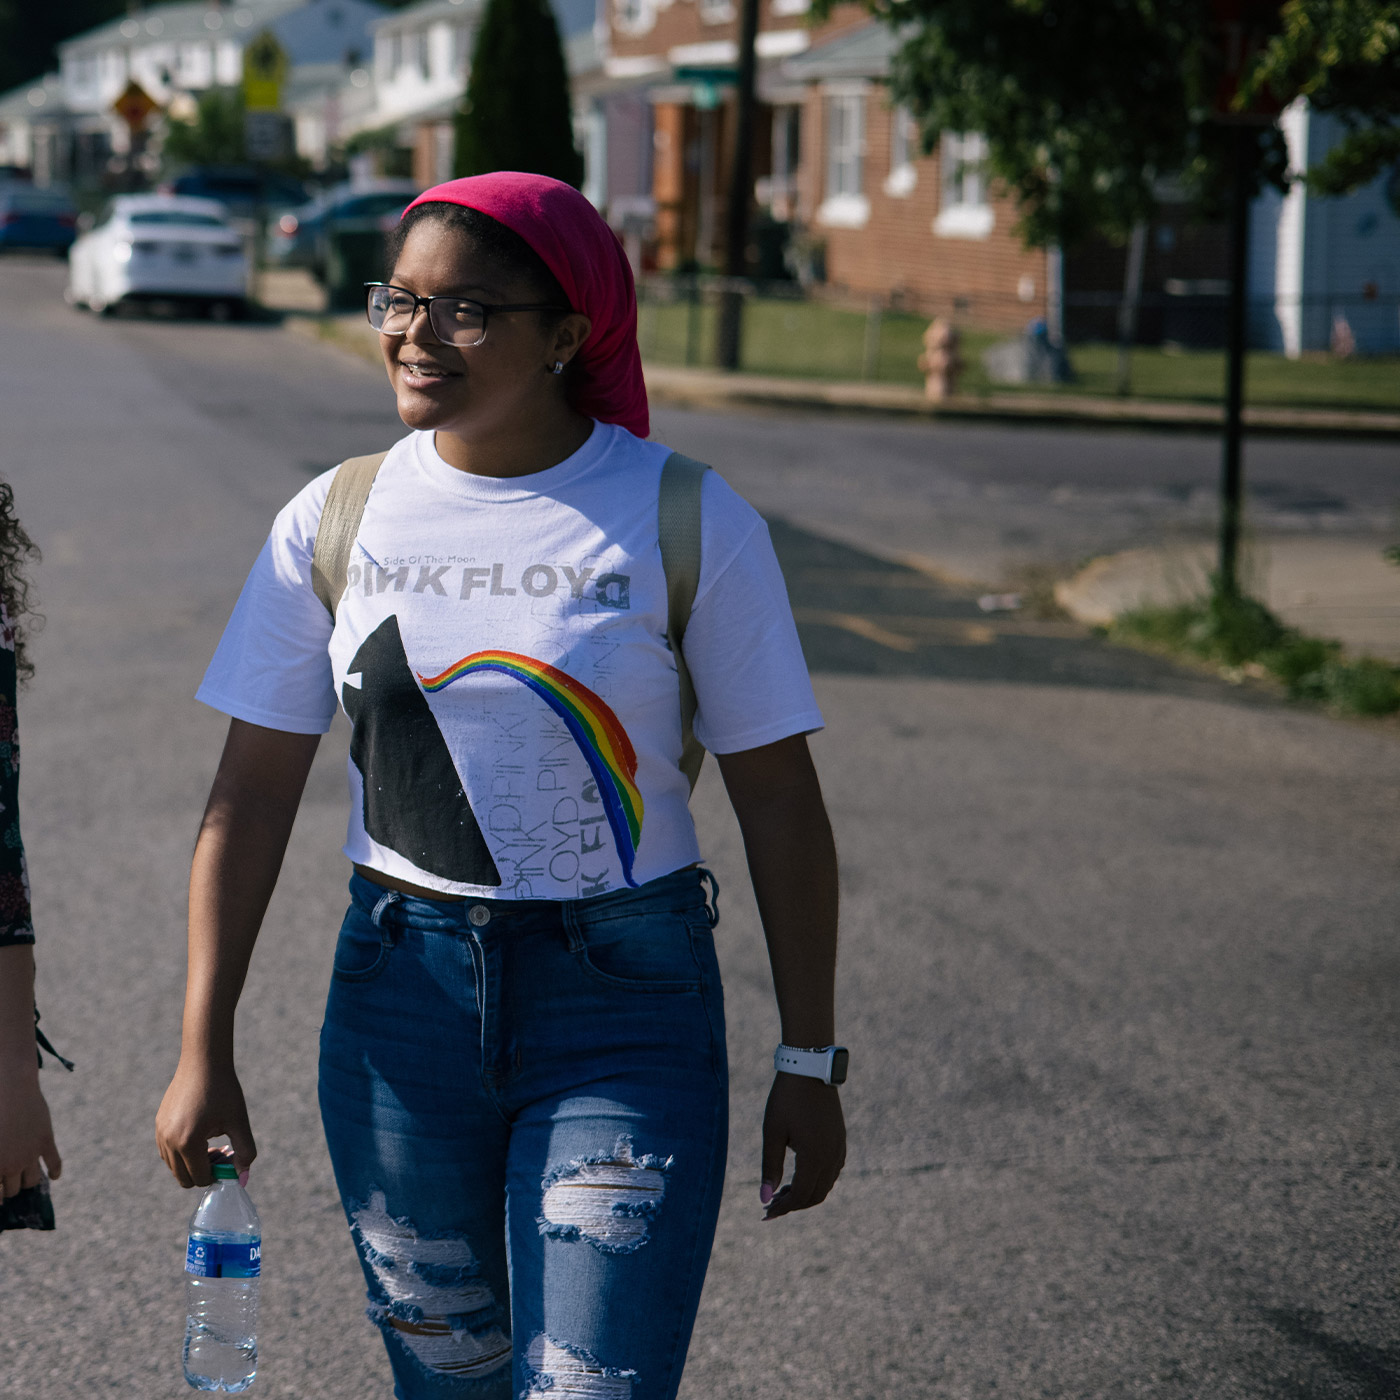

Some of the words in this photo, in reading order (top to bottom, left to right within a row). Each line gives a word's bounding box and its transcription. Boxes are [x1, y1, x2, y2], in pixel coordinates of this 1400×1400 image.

[384, 557, 405, 566] Side
[425, 555, 443, 565] The
[447, 555, 476, 565] Moon
[343, 562, 448, 601] PINK
